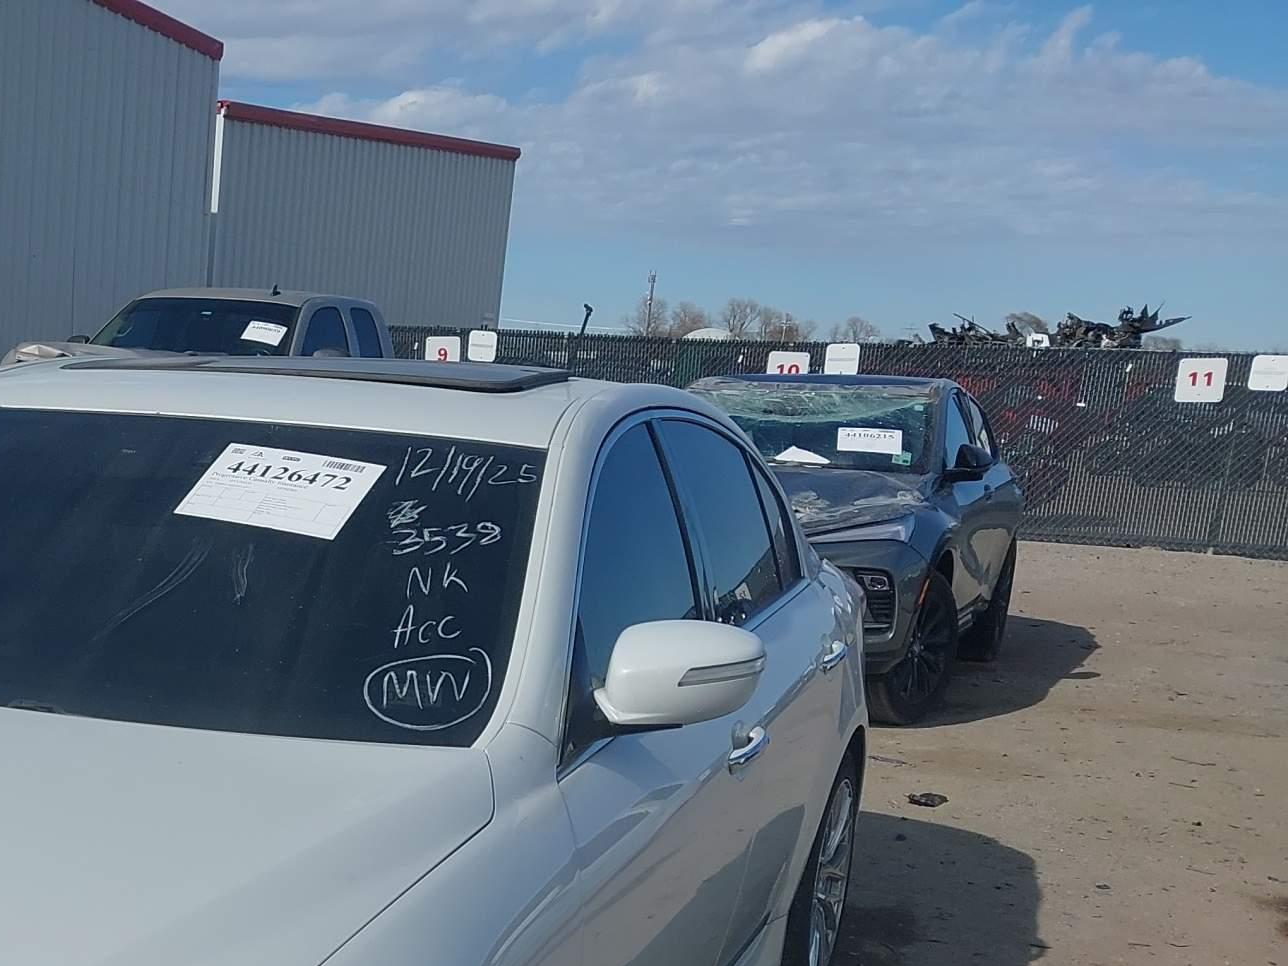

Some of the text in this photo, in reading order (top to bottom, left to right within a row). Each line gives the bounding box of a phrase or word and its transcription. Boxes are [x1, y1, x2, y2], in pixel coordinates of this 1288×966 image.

[437, 347, 448, 361] 9
[776, 363, 800, 375] 10
[1188, 371, 1213, 387] 11
[227, 460, 352, 490] 44126472
[395, 445, 537, 503] 12/19/25
